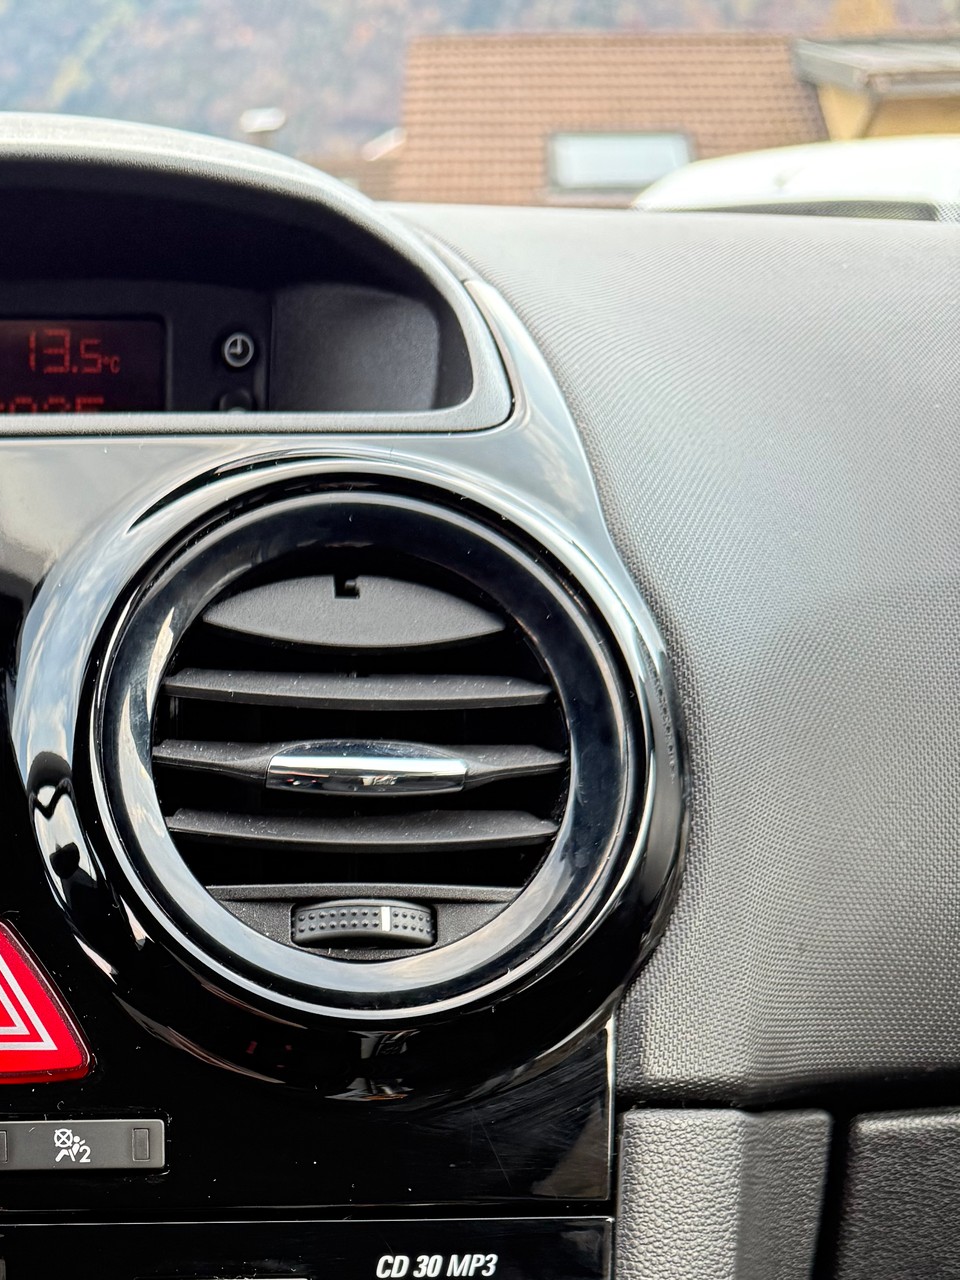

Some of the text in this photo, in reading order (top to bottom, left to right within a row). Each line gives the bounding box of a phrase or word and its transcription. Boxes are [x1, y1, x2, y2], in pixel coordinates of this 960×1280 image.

[79, 1145, 91, 1163] 2
[375, 1253, 499, 1279] CD 30 MP3
